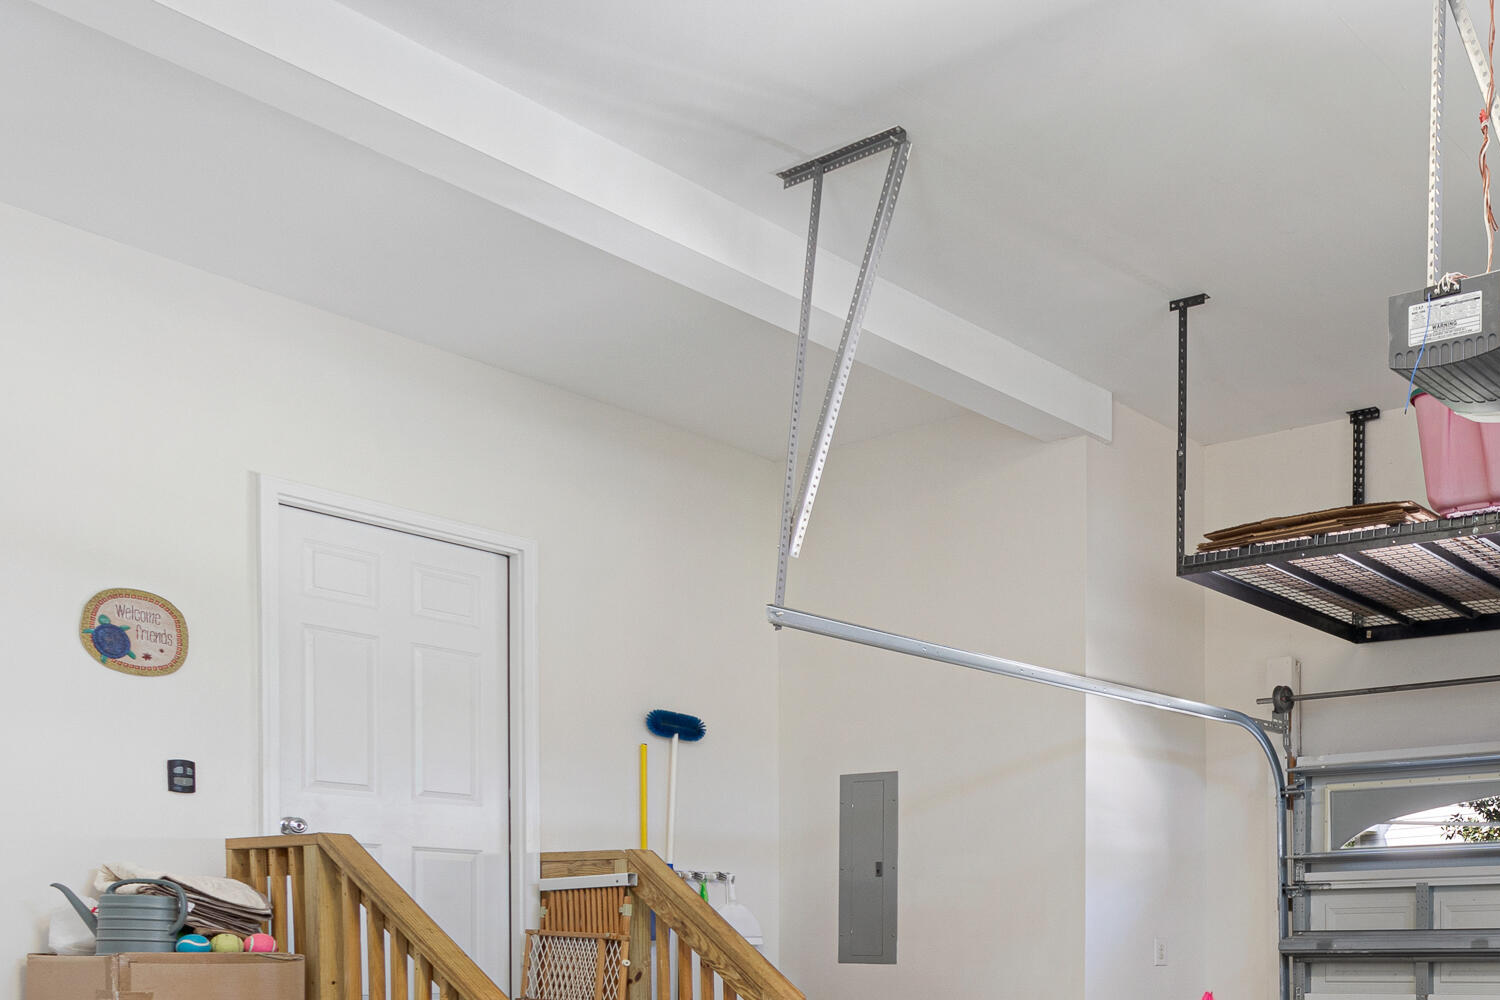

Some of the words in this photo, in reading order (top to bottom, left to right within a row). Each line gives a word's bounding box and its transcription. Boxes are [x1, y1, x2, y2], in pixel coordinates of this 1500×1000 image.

[1432, 320, 1458, 330] WARNING
[115, 604, 161, 626] Welcome
[135, 624, 173, 647] friends
